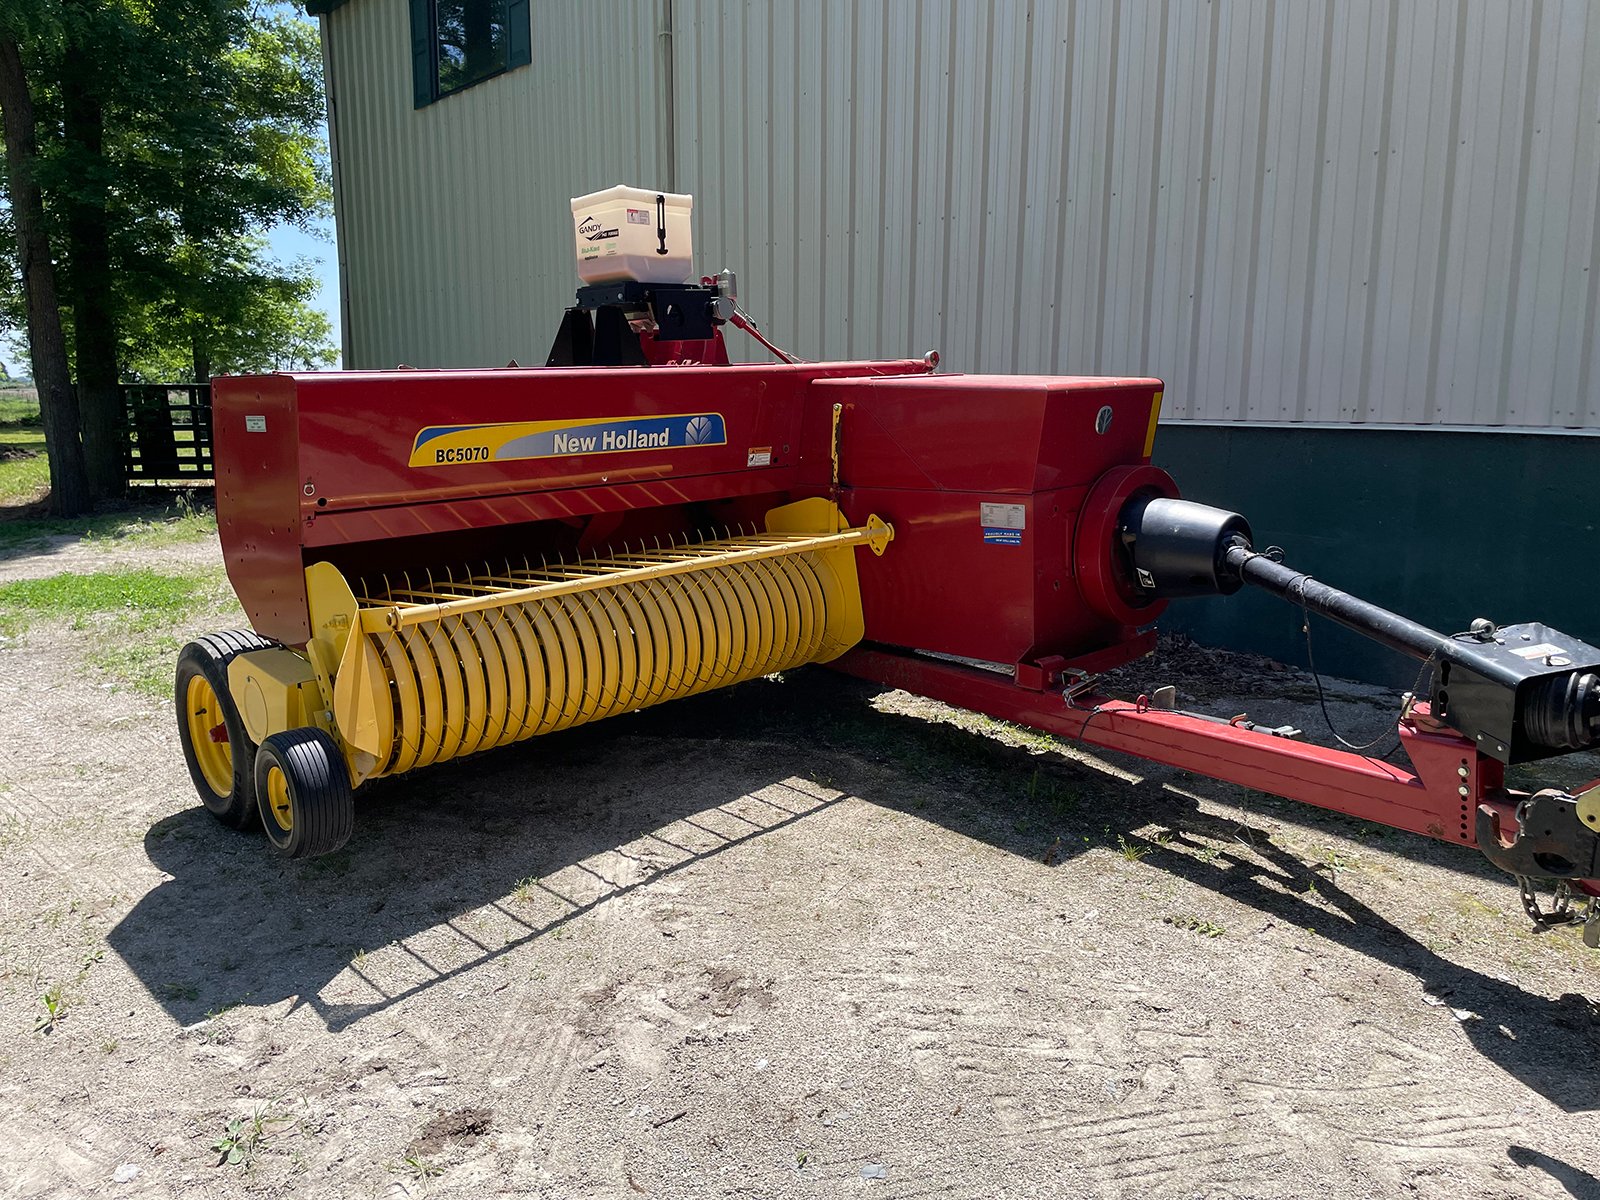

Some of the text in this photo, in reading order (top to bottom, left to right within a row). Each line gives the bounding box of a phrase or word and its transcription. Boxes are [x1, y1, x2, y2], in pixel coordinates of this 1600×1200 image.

[579, 223, 602, 234] GANDY
[553, 427, 670, 454] New Holland
[436, 446, 489, 463] BC5070
